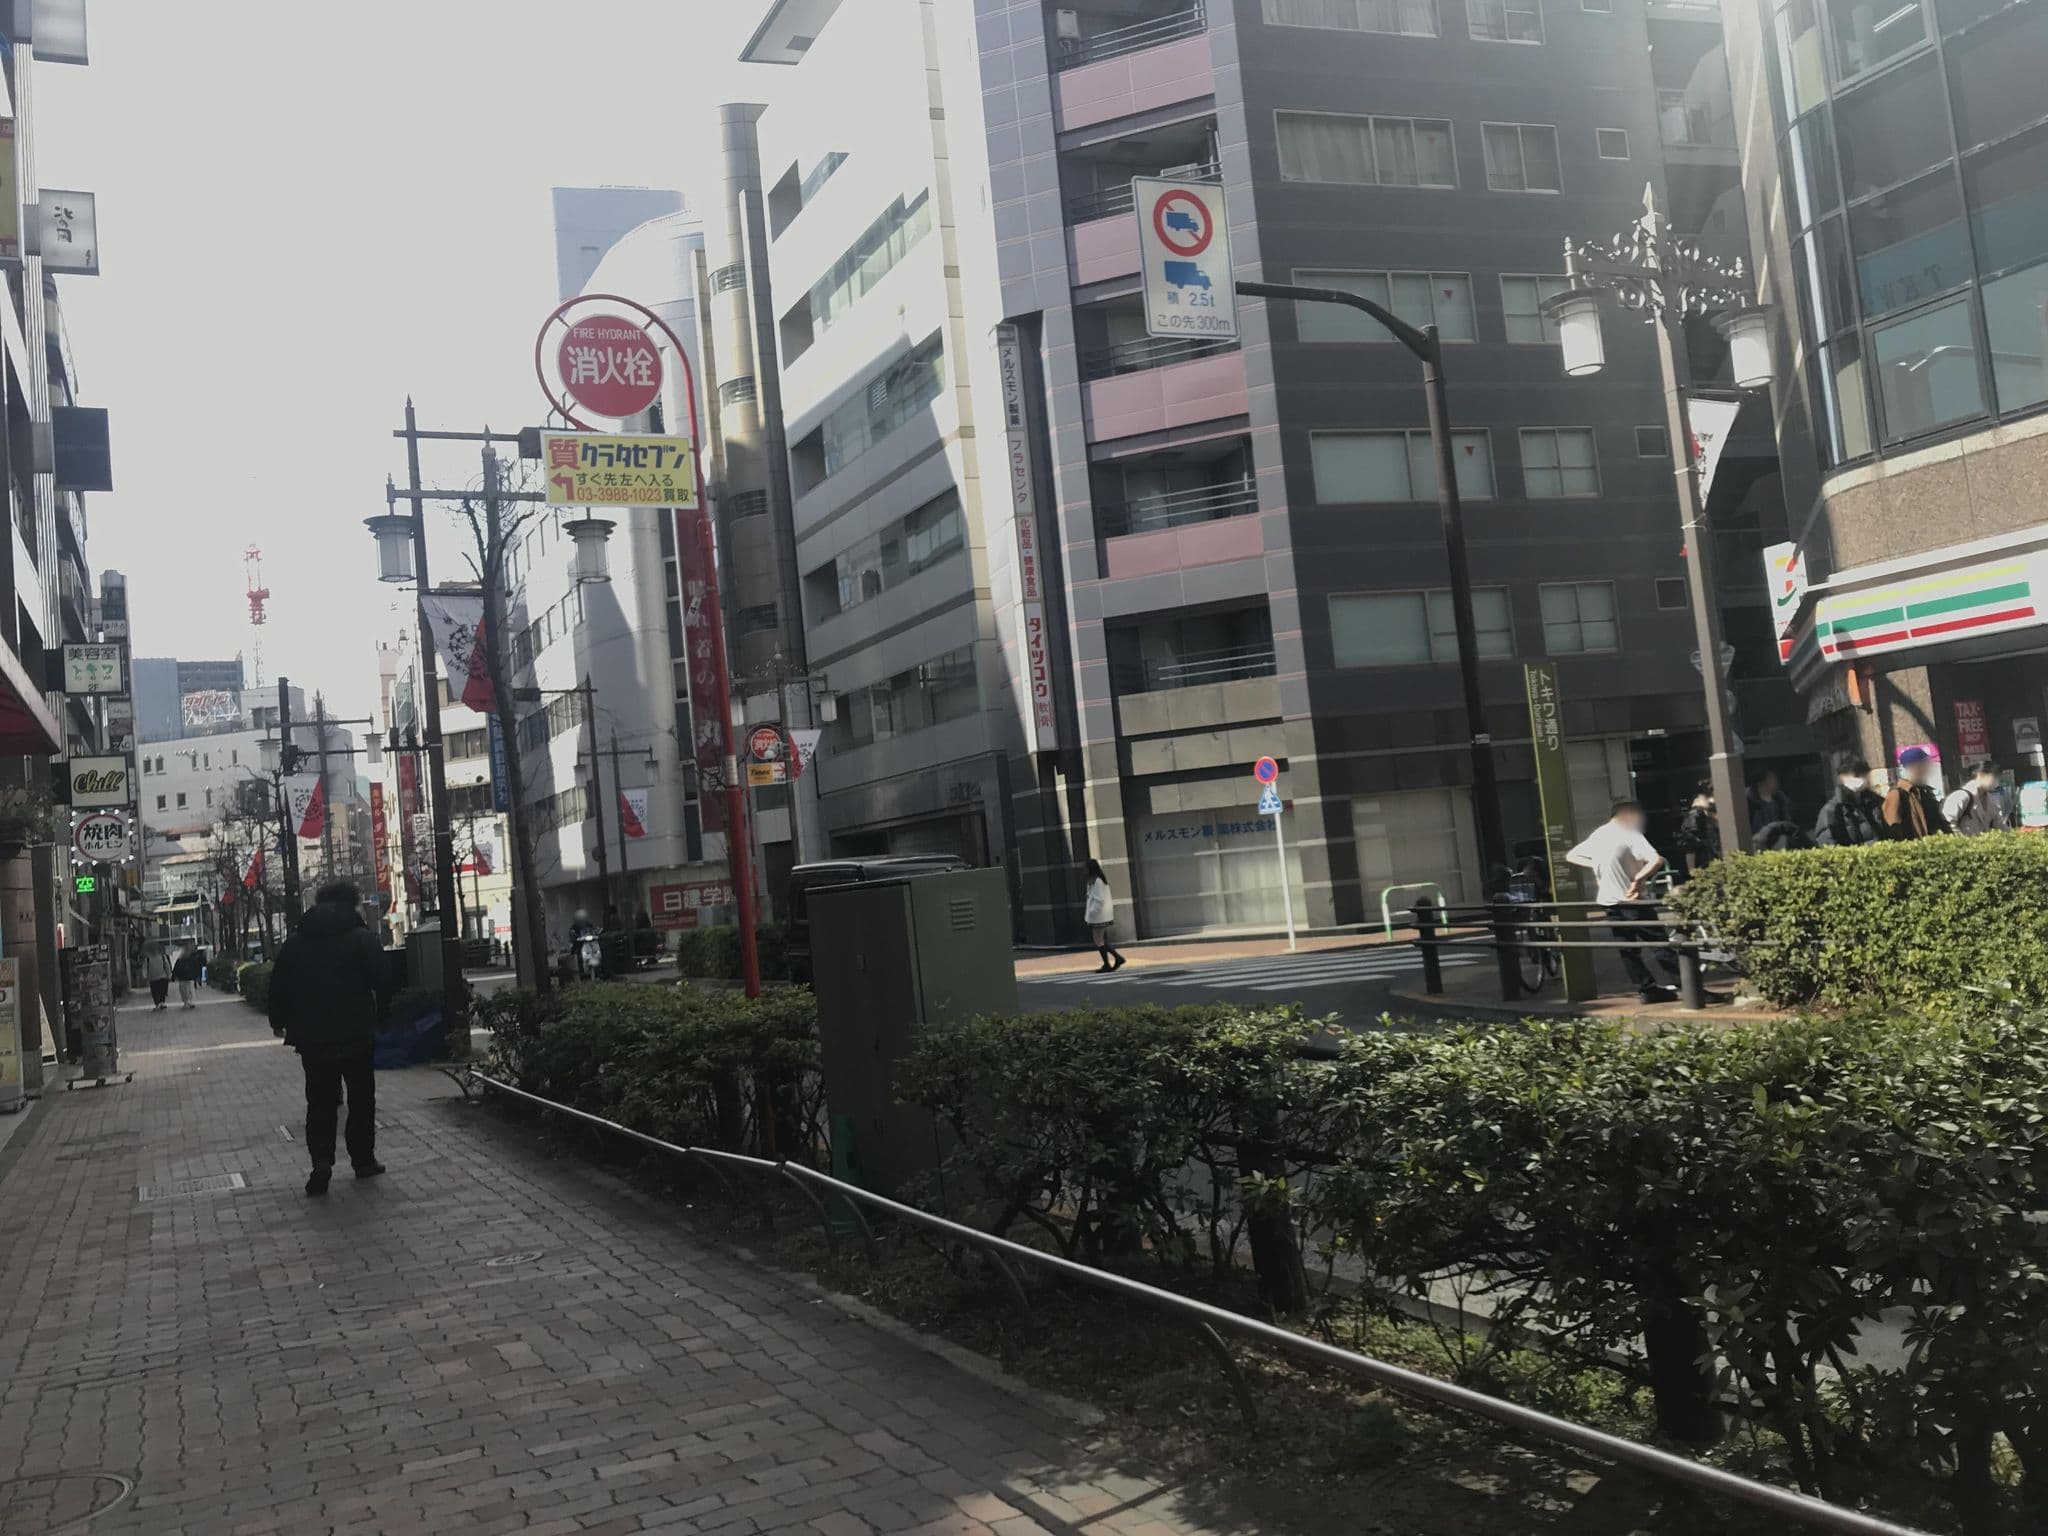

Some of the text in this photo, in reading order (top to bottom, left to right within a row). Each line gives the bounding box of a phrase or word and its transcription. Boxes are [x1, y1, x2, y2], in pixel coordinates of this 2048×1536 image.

[1157, 314, 1230, 331] この先300m
[573, 328, 641, 341] FIRE HYDRANT
[567, 345, 655, 386] 消火栓
[548, 439, 686, 470] 質 クラタセブン
[576, 473, 674, 488] すぐ先左へ入る
[577, 487, 690, 503] 03-3988-1023 買取
[68, 647, 116, 661] 美容室
[1538, 669, 1559, 752] トキワ通り
[1958, 717, 1984, 733] FREE
[74, 770, 125, 793] Chill
[83, 822, 123, 841] 焼肉
